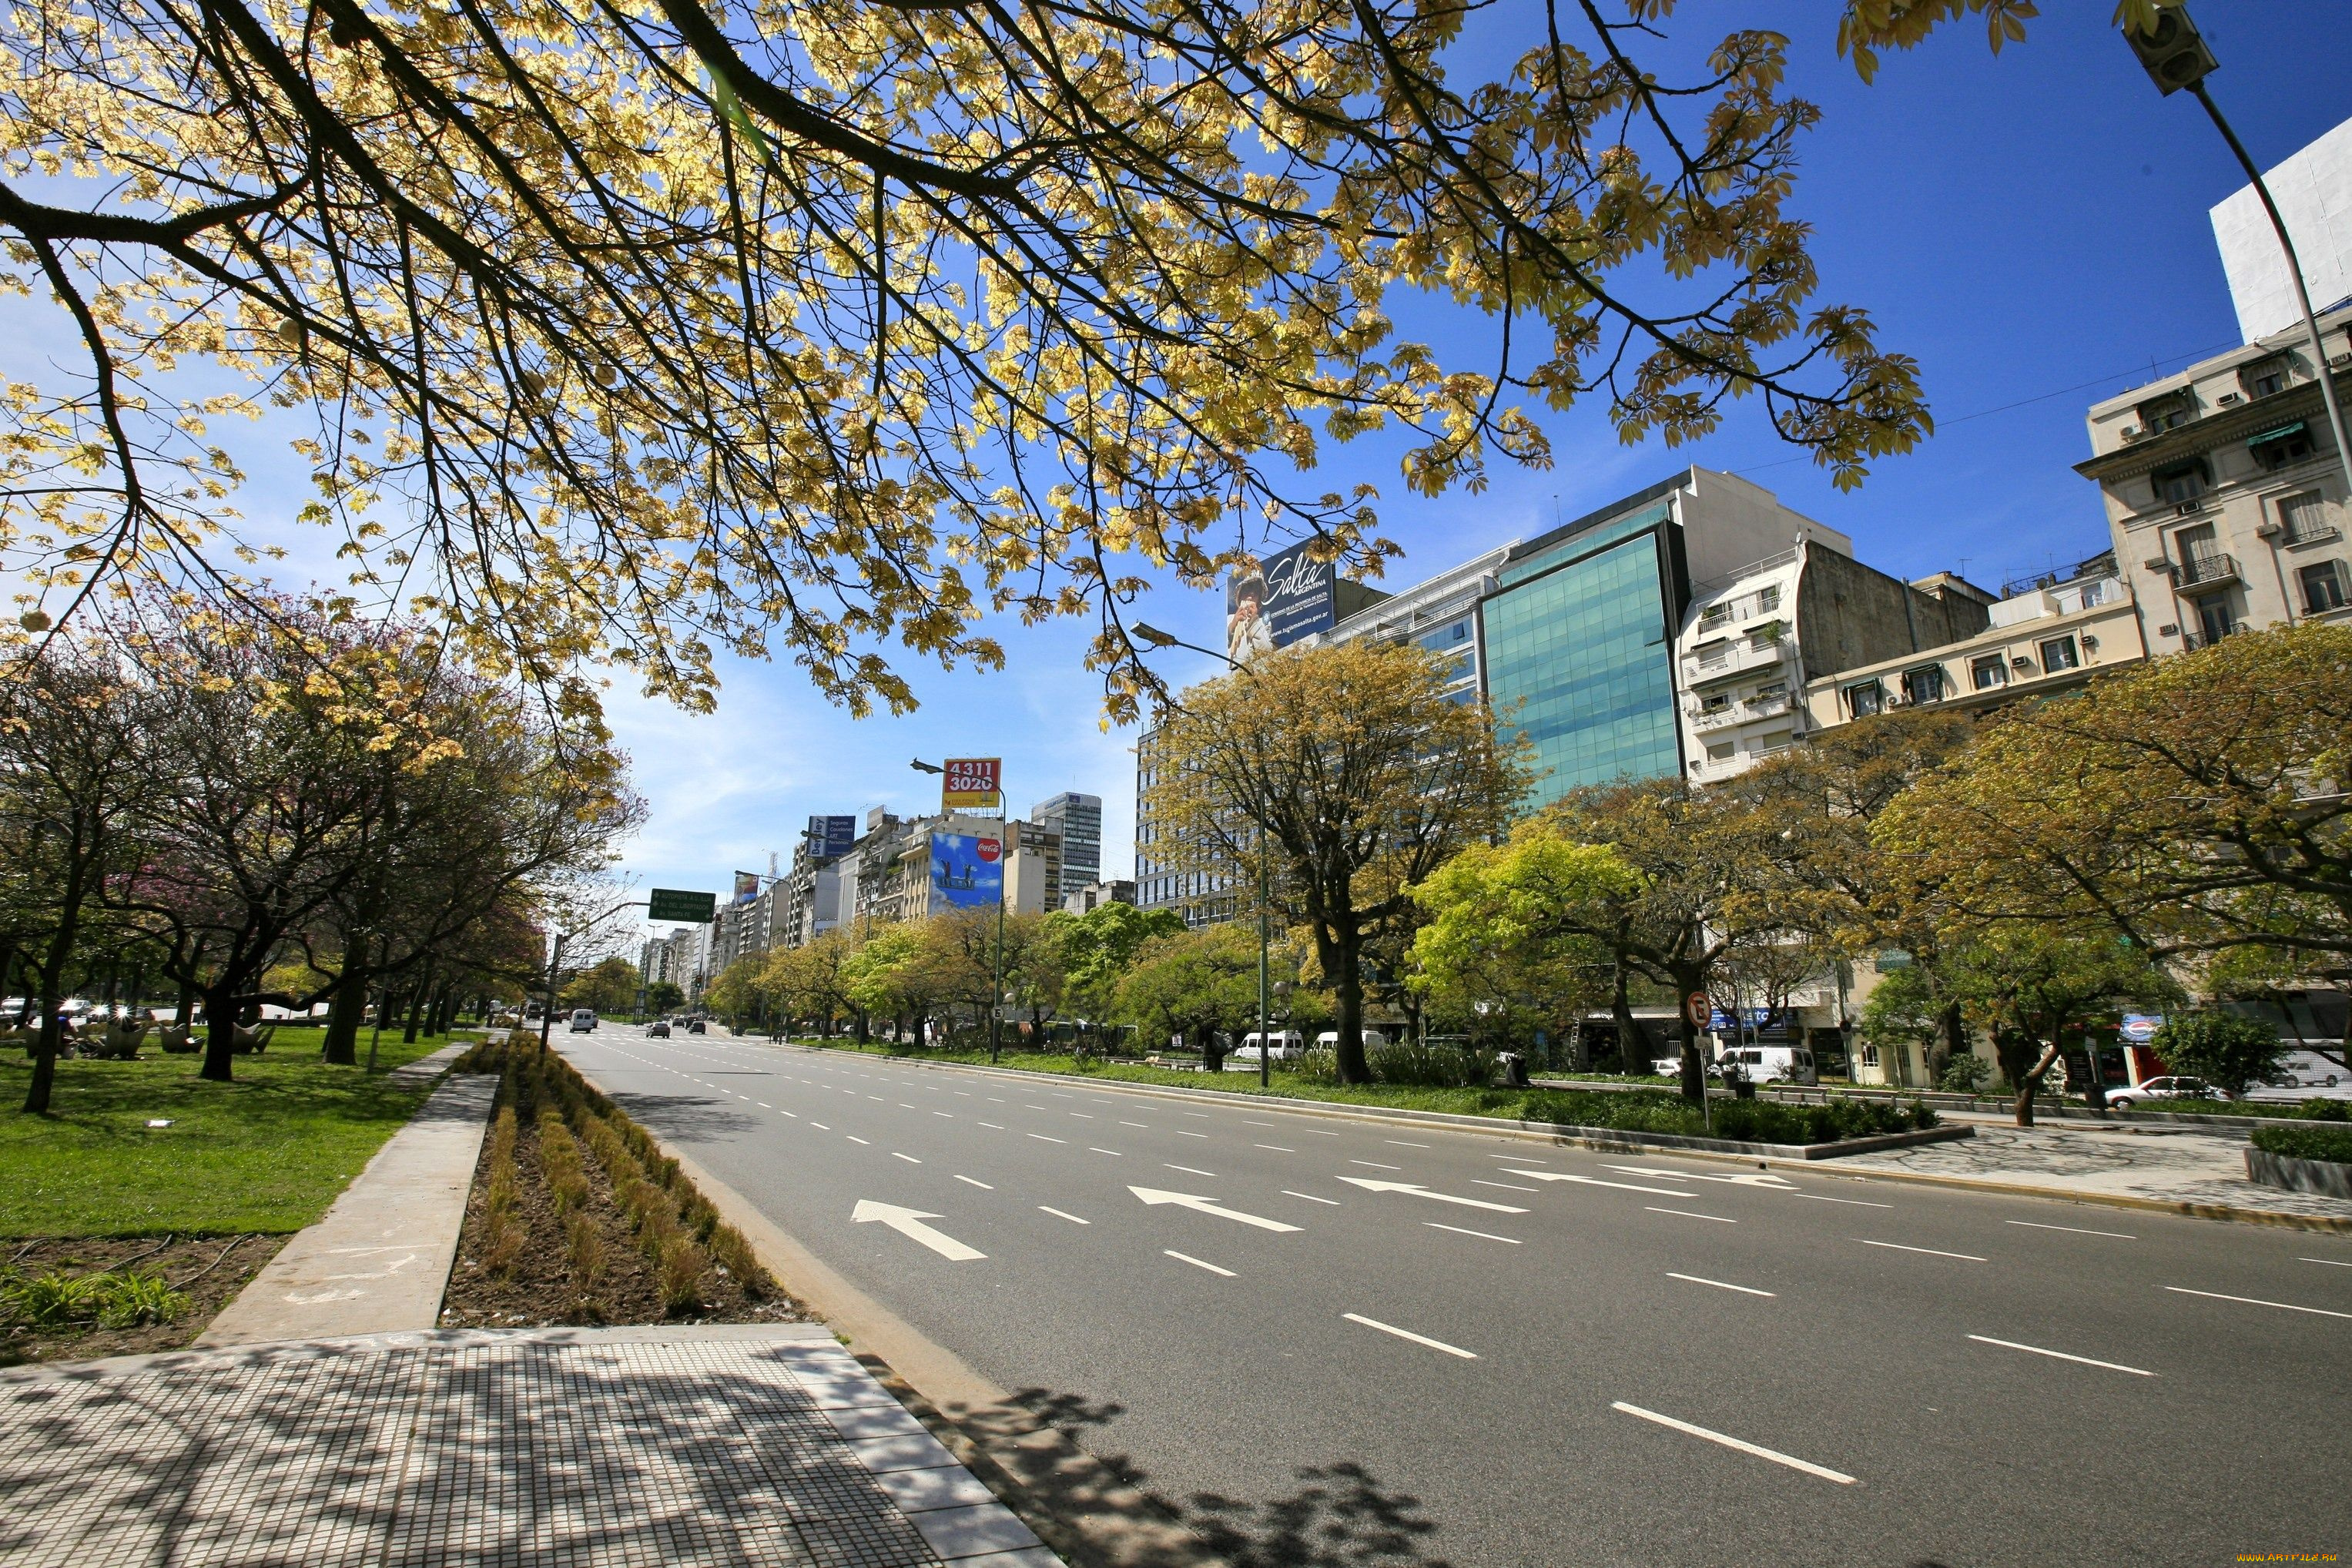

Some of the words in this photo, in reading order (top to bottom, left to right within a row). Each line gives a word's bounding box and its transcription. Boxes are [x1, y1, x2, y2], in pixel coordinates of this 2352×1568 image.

[1261, 552, 1326, 605] Salta
[1294, 579, 1325, 597] ARGENTINA
[1295, 598, 1312, 607] PROVINCIA
[950, 762, 991, 776] 4311
[950, 776, 993, 791] 3020
[812, 819, 825, 855] Berley
[1696, 1000, 1704, 1020] E
